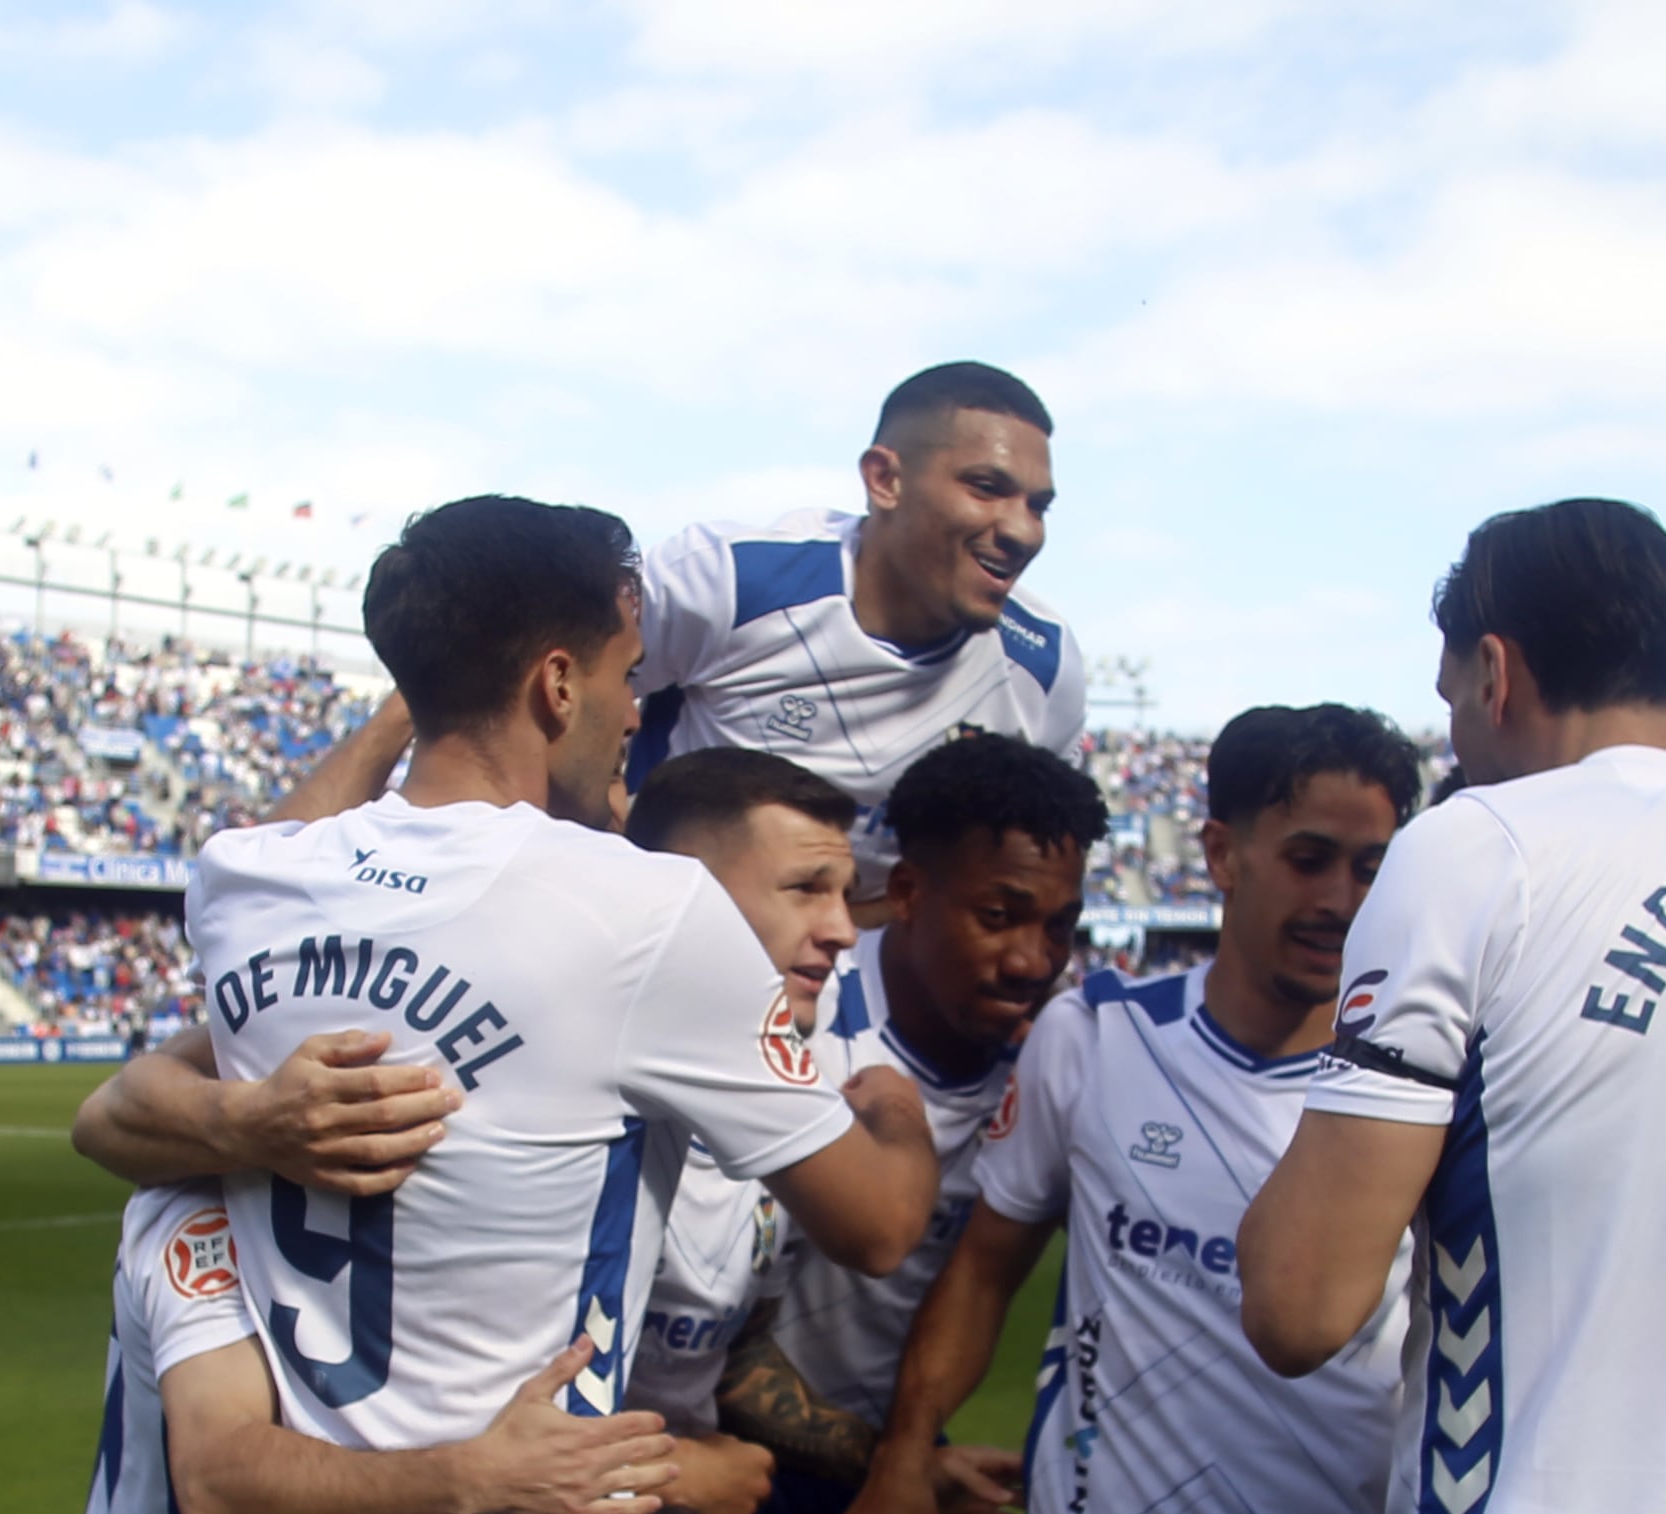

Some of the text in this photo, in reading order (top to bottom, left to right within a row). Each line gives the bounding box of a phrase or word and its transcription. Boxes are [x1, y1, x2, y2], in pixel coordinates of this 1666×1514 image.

[355, 866, 428, 895] DISA
[215, 934, 524, 1092] DE MIGUEL
[193, 1236, 223, 1254] RF
[195, 1252, 225, 1269] EF
[1106, 1202, 1241, 1277] tene
[269, 1172, 395, 1410] 9
